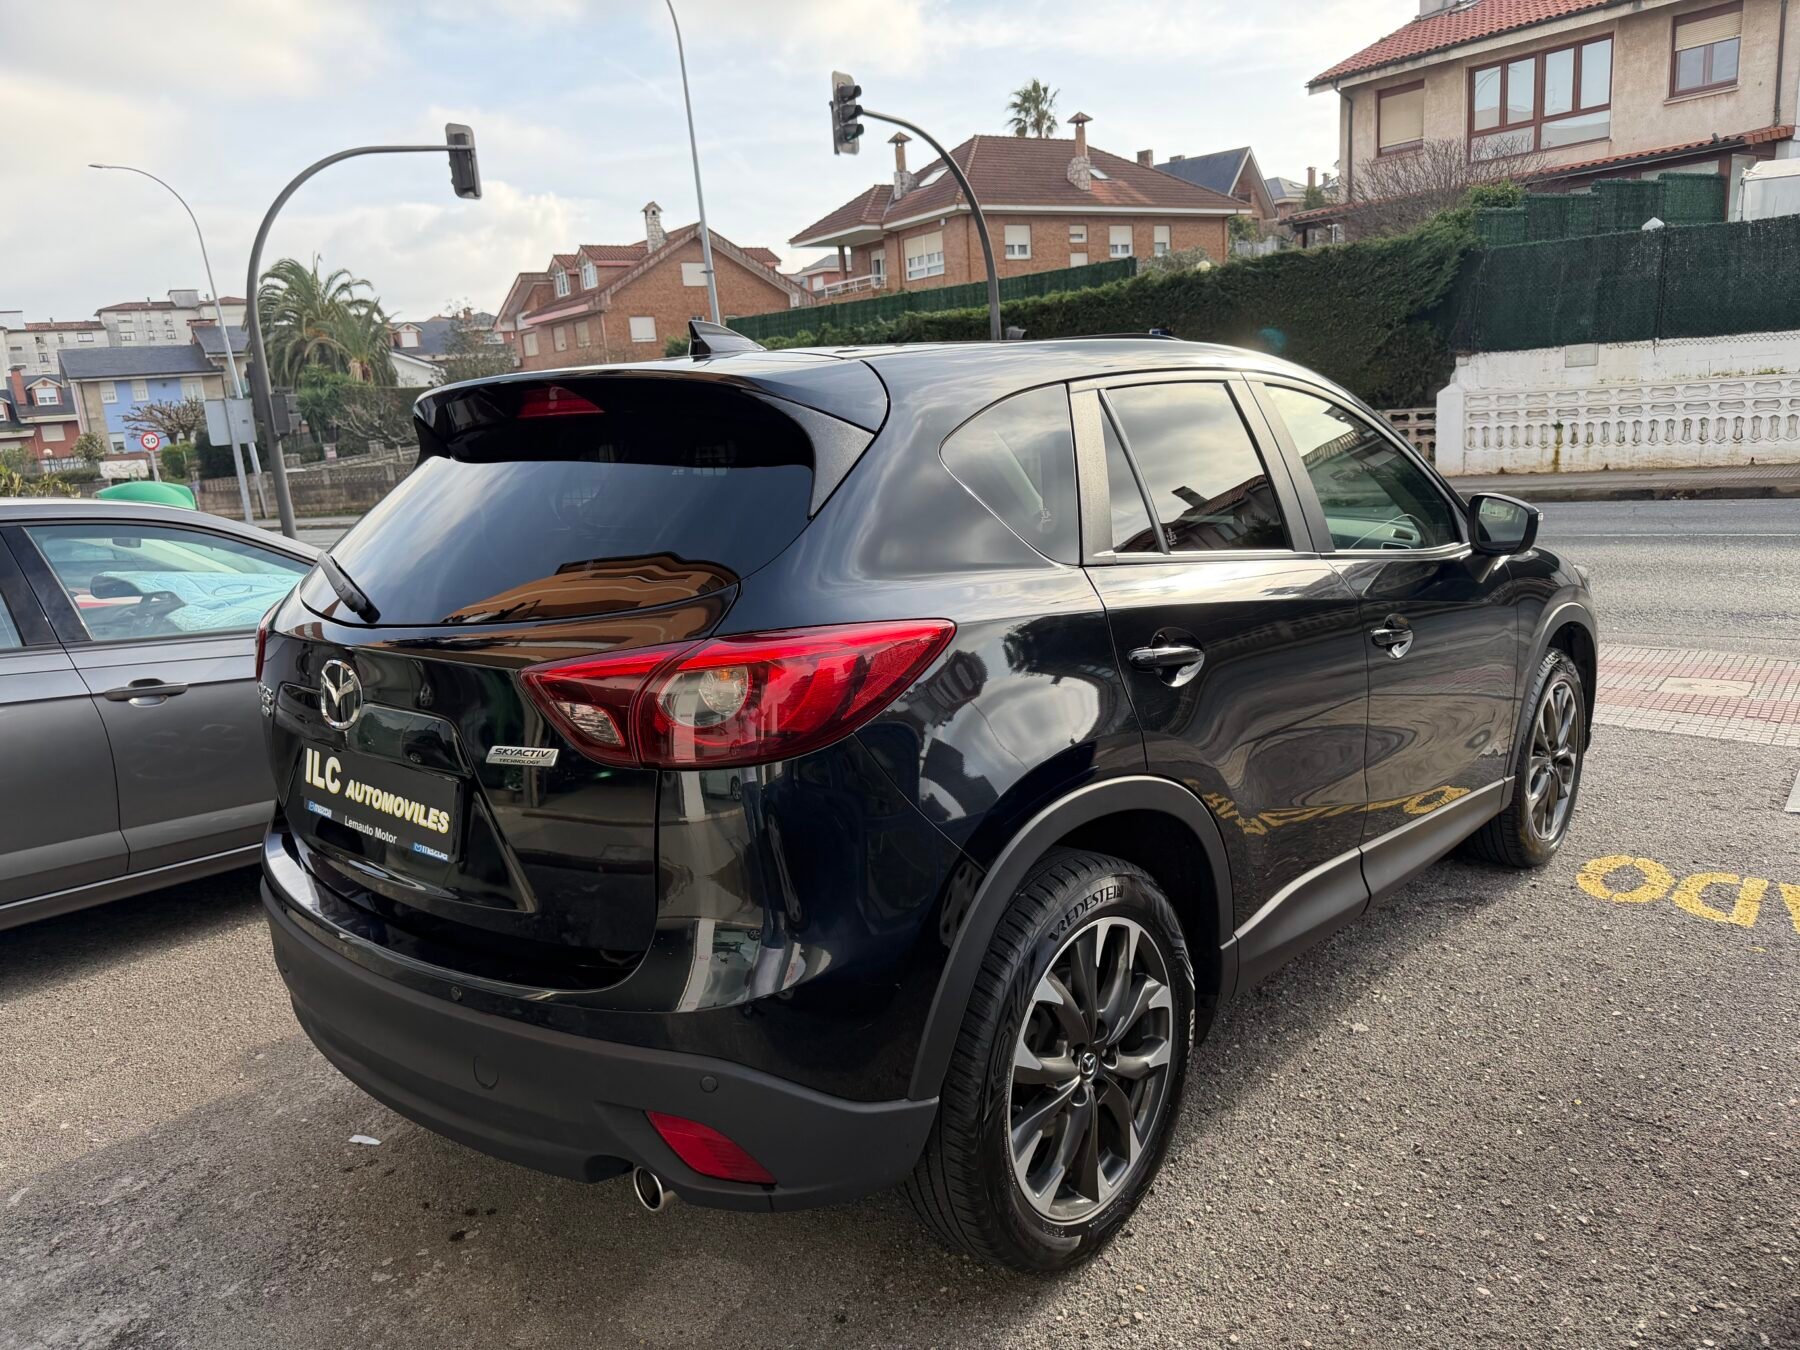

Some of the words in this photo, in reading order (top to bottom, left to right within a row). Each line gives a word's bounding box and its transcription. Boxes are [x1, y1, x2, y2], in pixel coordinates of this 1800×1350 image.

[144, 437, 156, 445] 30
[494, 747, 551, 758] SKYACTIV
[305, 747, 342, 794] ILC
[345, 779, 450, 834] AUTOMOVILES
[344, 815, 374, 837] Lemauto
[374, 826, 397, 844] Motor
[1048, 884, 1124, 942] VREDESTEIN
[1576, 854, 1800, 935] DO
